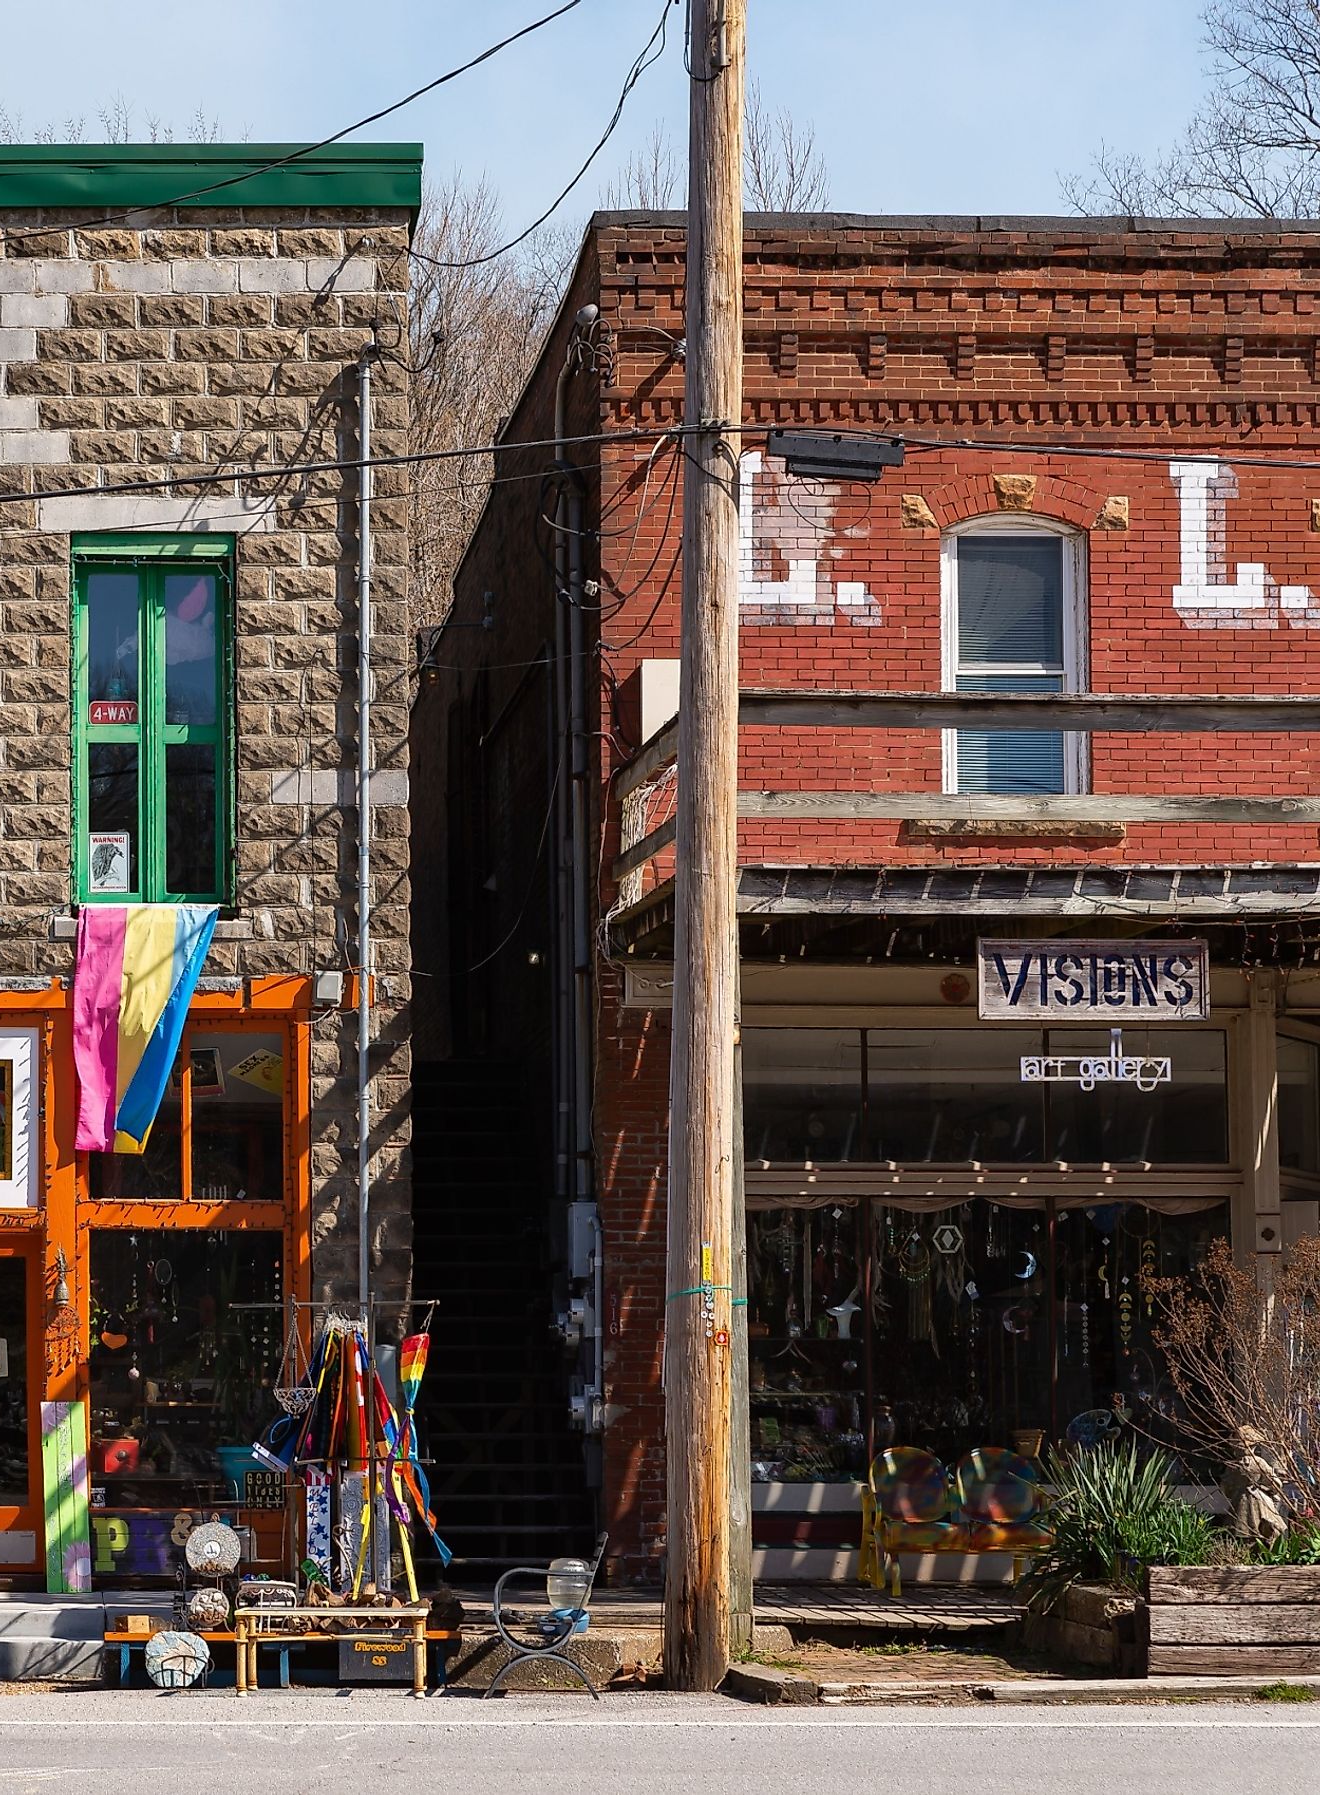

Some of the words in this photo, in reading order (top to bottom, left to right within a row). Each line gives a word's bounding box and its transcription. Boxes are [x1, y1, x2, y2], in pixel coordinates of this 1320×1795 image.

[1169, 455, 1309, 608] L.
[93, 706, 135, 721] 4-WAY
[92, 836, 125, 844] WARNING!
[992, 953, 1194, 1007] VISIONS
[1022, 1058, 1067, 1080] art
[1079, 1028, 1168, 1092] gallery
[246, 1472, 281, 1485] GOOD
[354, 1641, 406, 1652] Firewood
